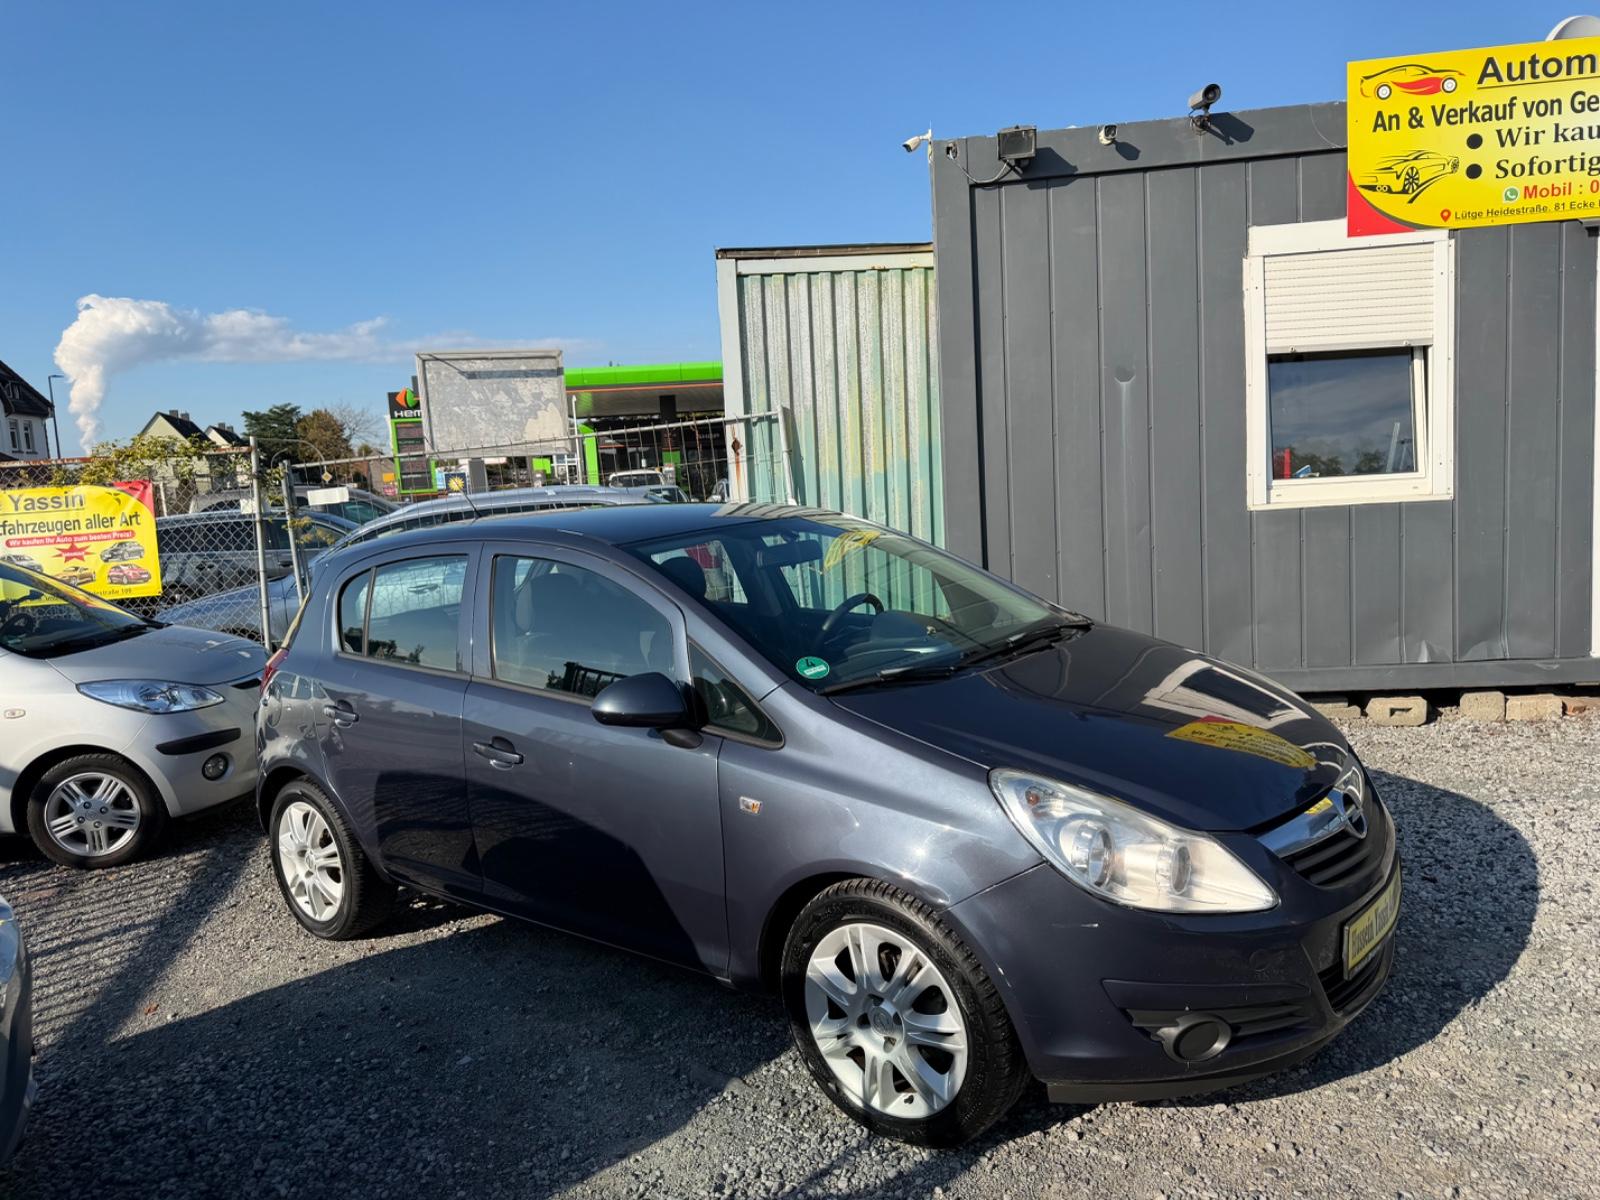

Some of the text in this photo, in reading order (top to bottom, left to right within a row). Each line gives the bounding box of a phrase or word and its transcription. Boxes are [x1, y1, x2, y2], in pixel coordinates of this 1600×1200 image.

[1477, 53, 1597, 85] Autom
[1372, 90, 1600, 133] An & Verkauf von Ge
[1496, 122, 1600, 148] Wir kau
[1495, 152, 1600, 179] Sofortig
[1523, 182, 1572, 199] Mobil
[1590, 179, 1600, 194] 0
[1454, 209, 1483, 221] Lütge
[1554, 202, 1565, 211] 81
[1569, 200, 1595, 210] Ecke
[8, 491, 84, 511] Yassin
[85, 513, 115, 529] aller
[120, 511, 141, 527] Art
[22, 538, 44, 546] kaufen
[89, 533, 112, 541] besten
[112, 531, 132, 539] Preis!
[804, 658, 816, 668] 4
